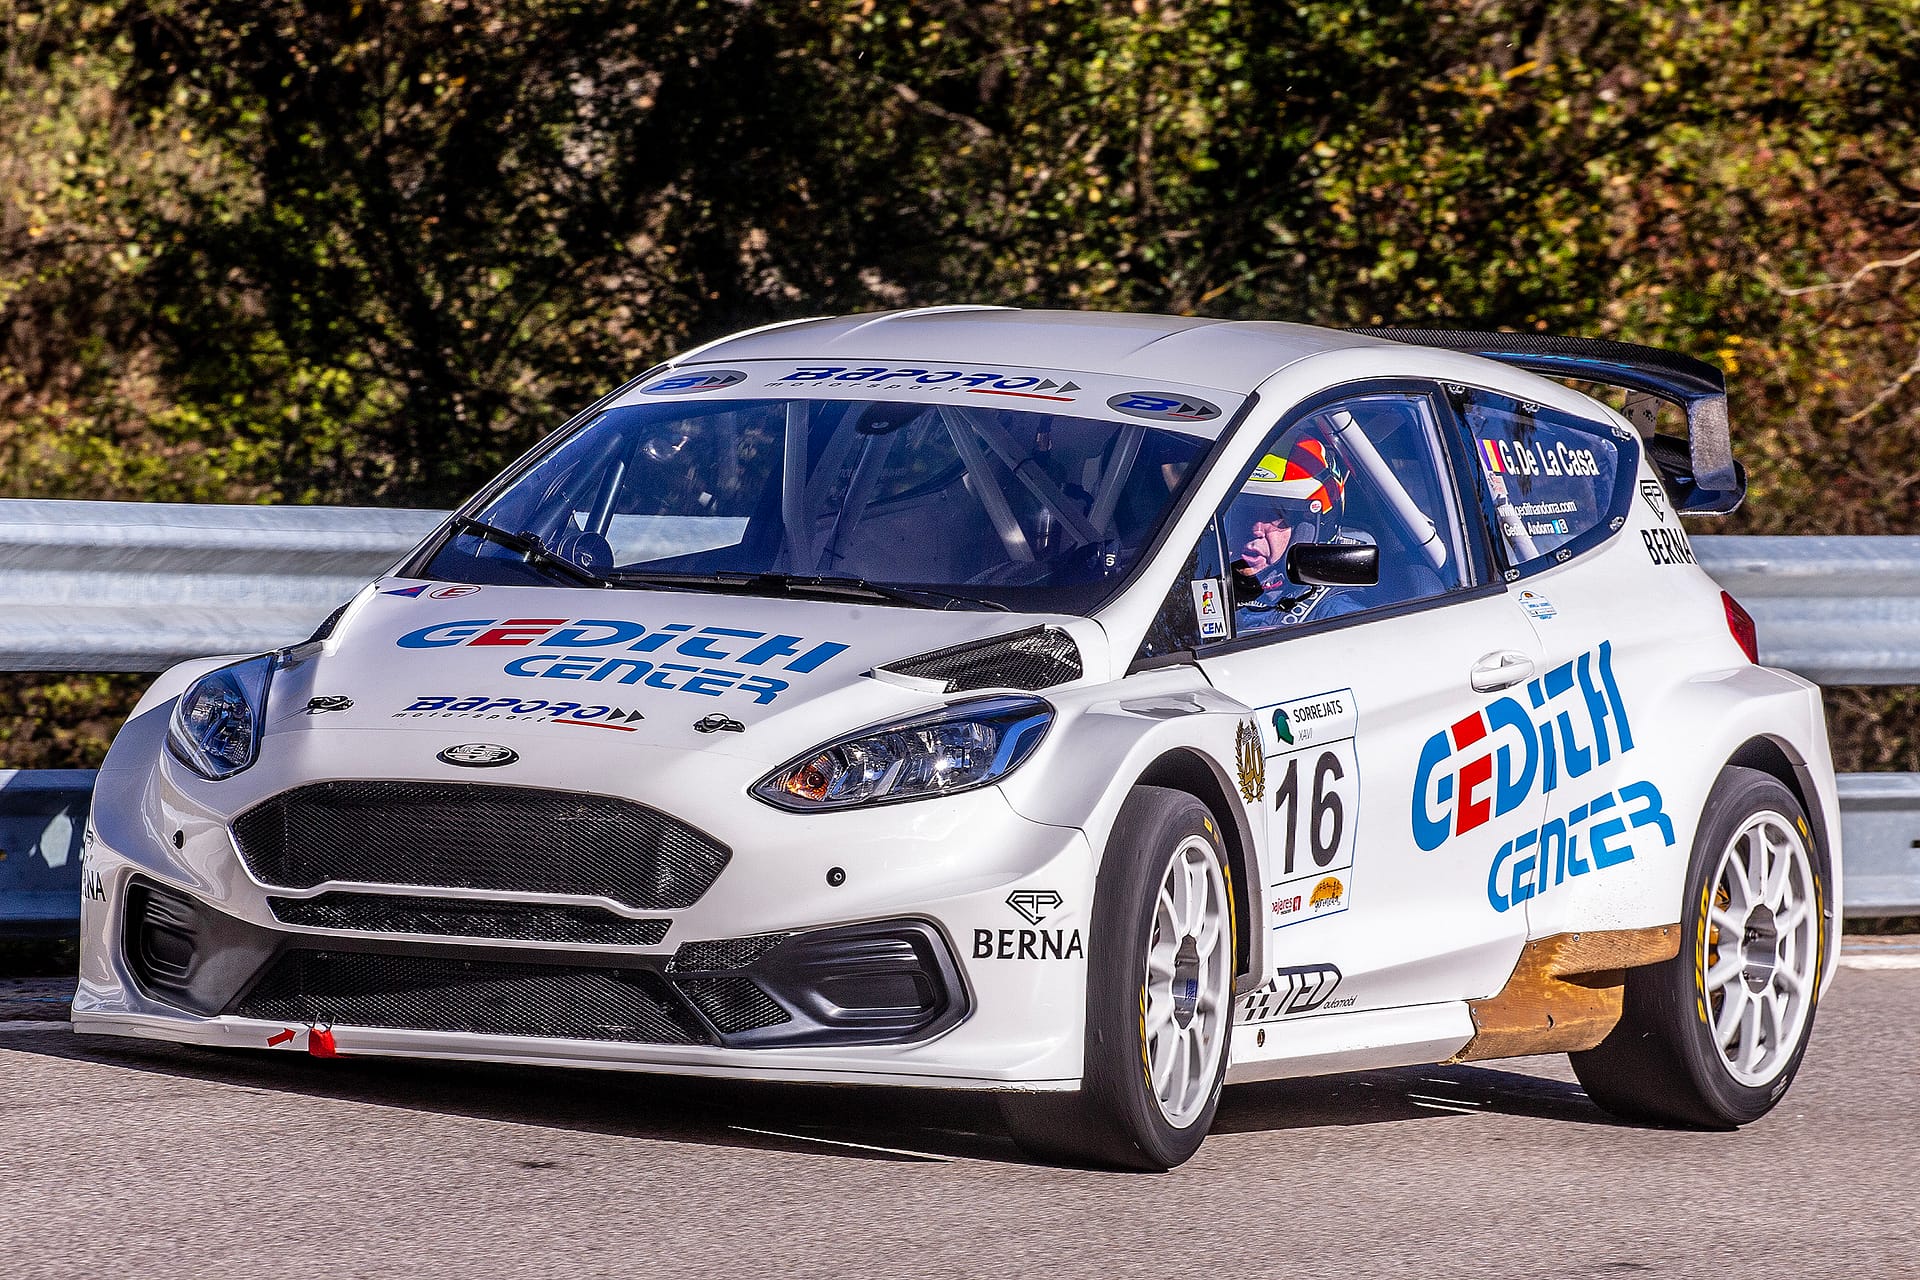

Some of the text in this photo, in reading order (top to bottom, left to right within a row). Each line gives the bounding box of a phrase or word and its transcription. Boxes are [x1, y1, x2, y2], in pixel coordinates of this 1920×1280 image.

[763, 382, 959, 392] motorsport
[1513, 441, 1540, 476] De
[1535, 441, 1563, 476] La
[1556, 441, 1600, 476] Casa
[1640, 528, 1698, 566] BERNA
[1202, 622, 1224, 634] CEM
[391, 711, 547, 722] motorsport
[1293, 700, 1343, 723] SORREJATS
[1298, 728, 1313, 741] XAVI
[1275, 751, 1344, 874] 16
[972, 929, 1084, 959] BERNA
